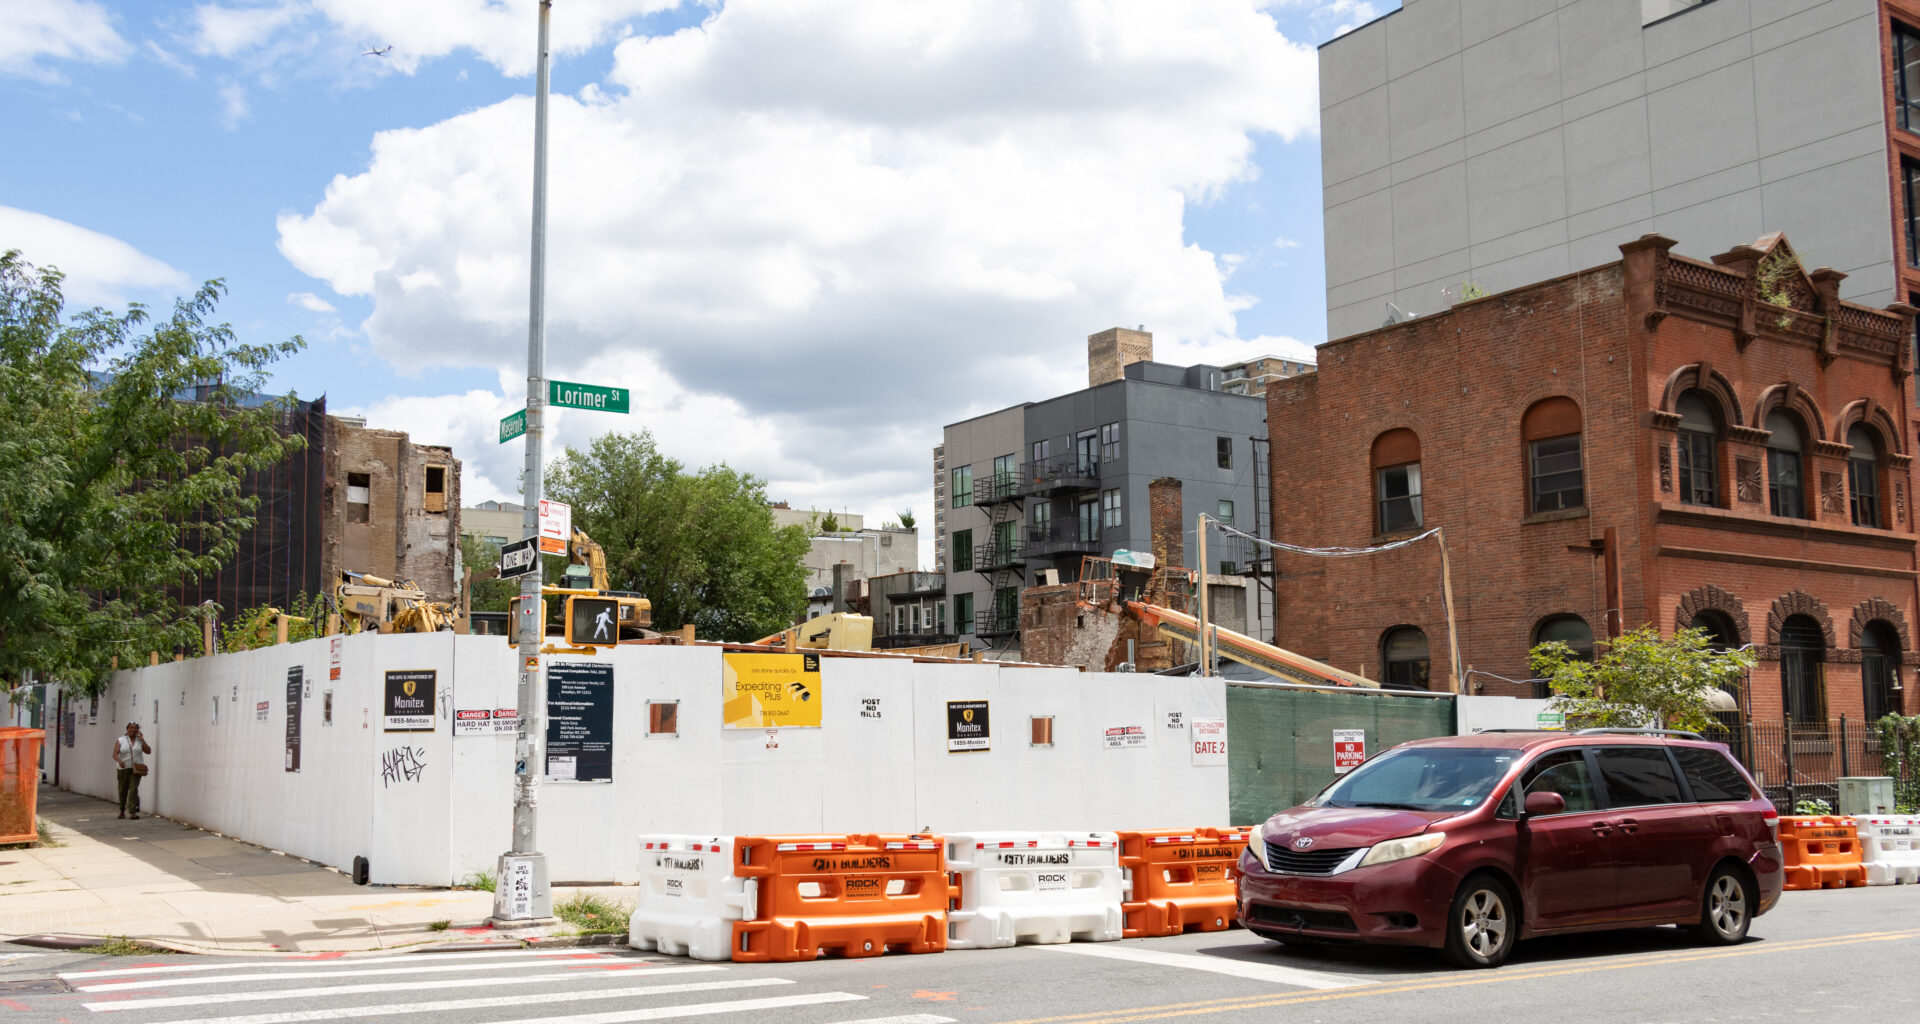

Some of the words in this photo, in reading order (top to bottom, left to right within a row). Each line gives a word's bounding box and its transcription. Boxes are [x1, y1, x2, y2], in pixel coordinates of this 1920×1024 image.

[557, 385, 607, 408] Lorimer
[611, 389, 620, 401] St
[506, 553, 518, 568] ONE
[522, 547, 533, 564] WAY
[735, 682, 782, 693] Expediting
[765, 691, 782, 701] Plus
[394, 695, 425, 709] Monitex
[461, 711, 486, 719] DANGER
[498, 709, 518, 717] DANGE
[956, 721, 982, 733] Monitex
[1194, 741, 1217, 754] GATE
[1219, 741, 1225, 754] 2
[1345, 743, 1355, 752] NO
[1336, 751, 1363, 760] PARKING
[1196, 847, 1233, 858] BUILDERS
[840, 857, 891, 869] BUILDERS
[1027, 853, 1069, 864] BUILDERS
[1196, 865, 1221, 874] ROCK
[1038, 874, 1067, 882] ROCK
[667, 879, 683, 888] ROCK
[846, 879, 879, 888] ROCK
